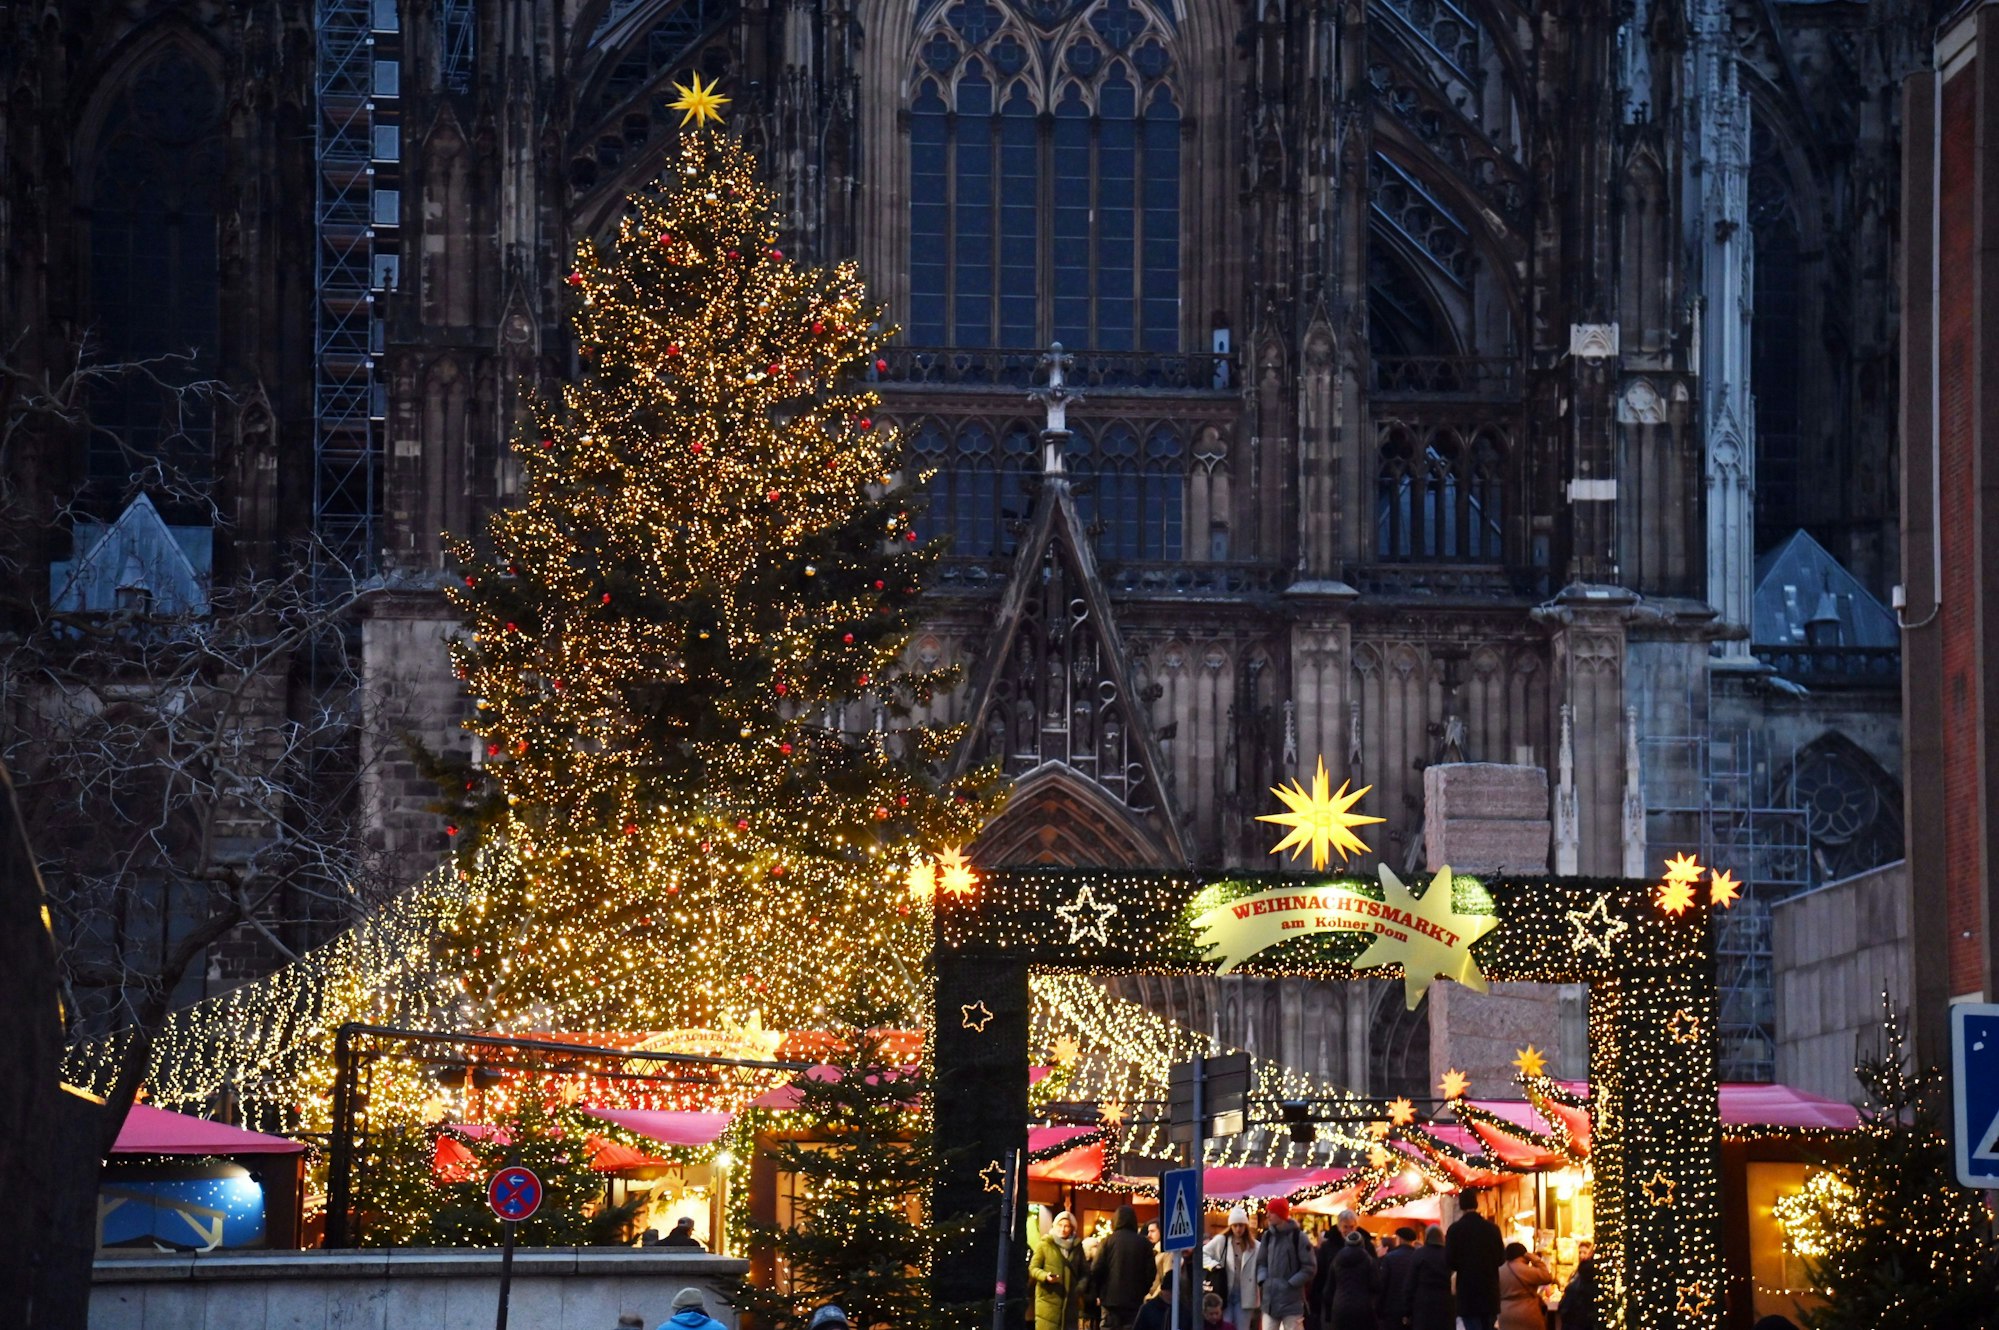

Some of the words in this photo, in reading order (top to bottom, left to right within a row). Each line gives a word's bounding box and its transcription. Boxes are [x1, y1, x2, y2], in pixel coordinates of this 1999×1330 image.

[1231, 895, 1461, 948] WEIHNACHTSMARKT
[1281, 919, 1305, 930] am
[1315, 917, 1369, 931] Kölner
[1373, 921, 1408, 943] Dom
